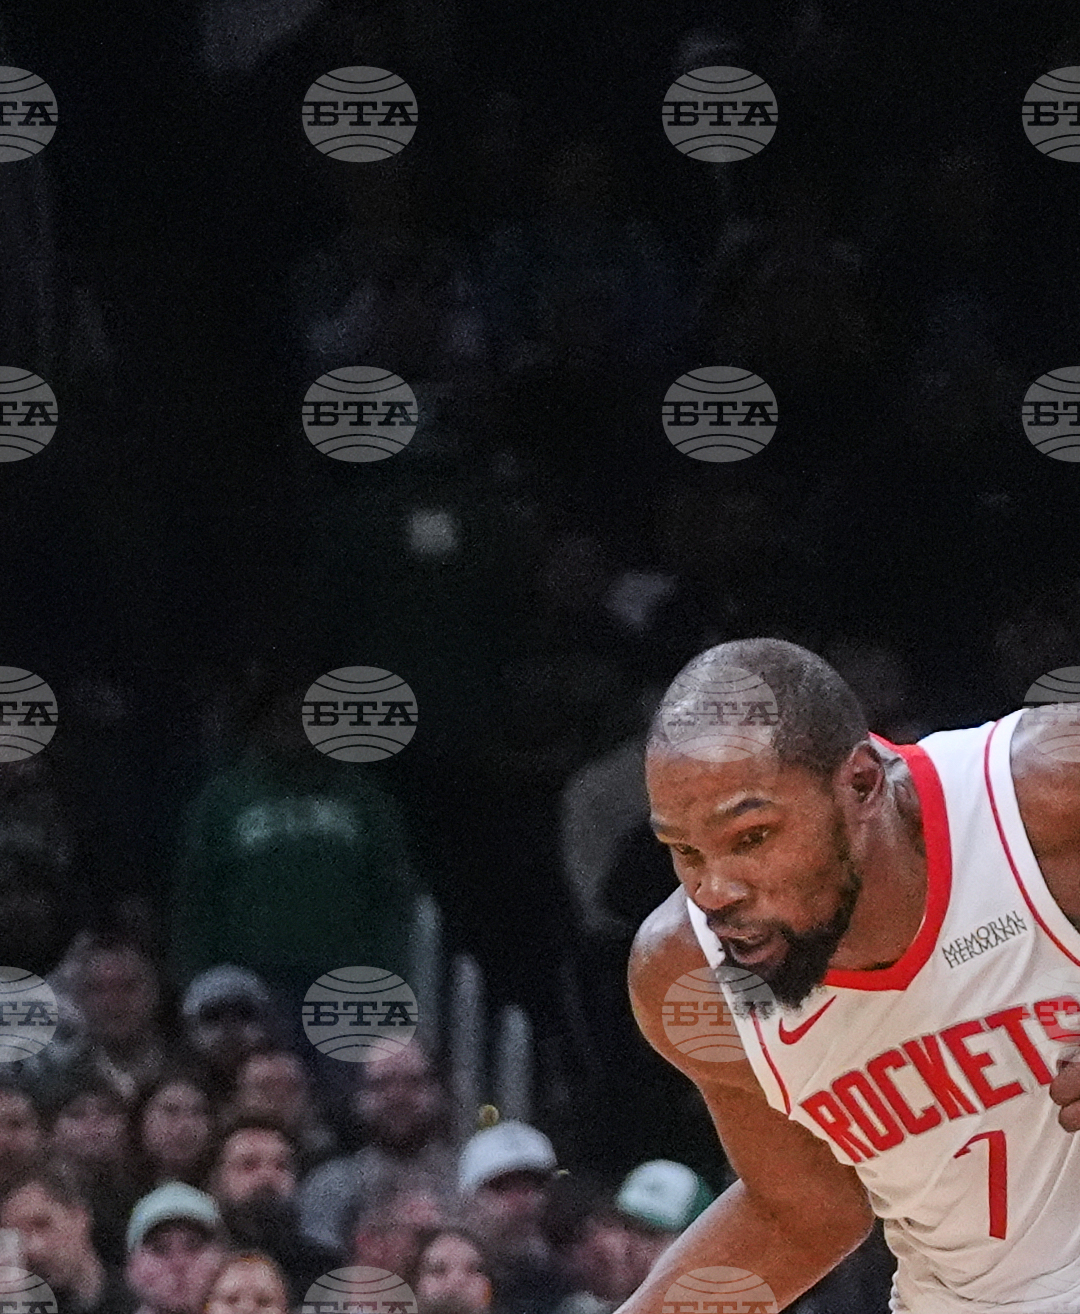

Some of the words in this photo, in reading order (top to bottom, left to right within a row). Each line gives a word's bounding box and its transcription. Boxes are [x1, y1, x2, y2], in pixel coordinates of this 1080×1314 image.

[942, 910, 1024, 957] MEMORIAL
[944, 919, 1028, 969] HERMANN
[953, 1129, 1008, 1240] 7
